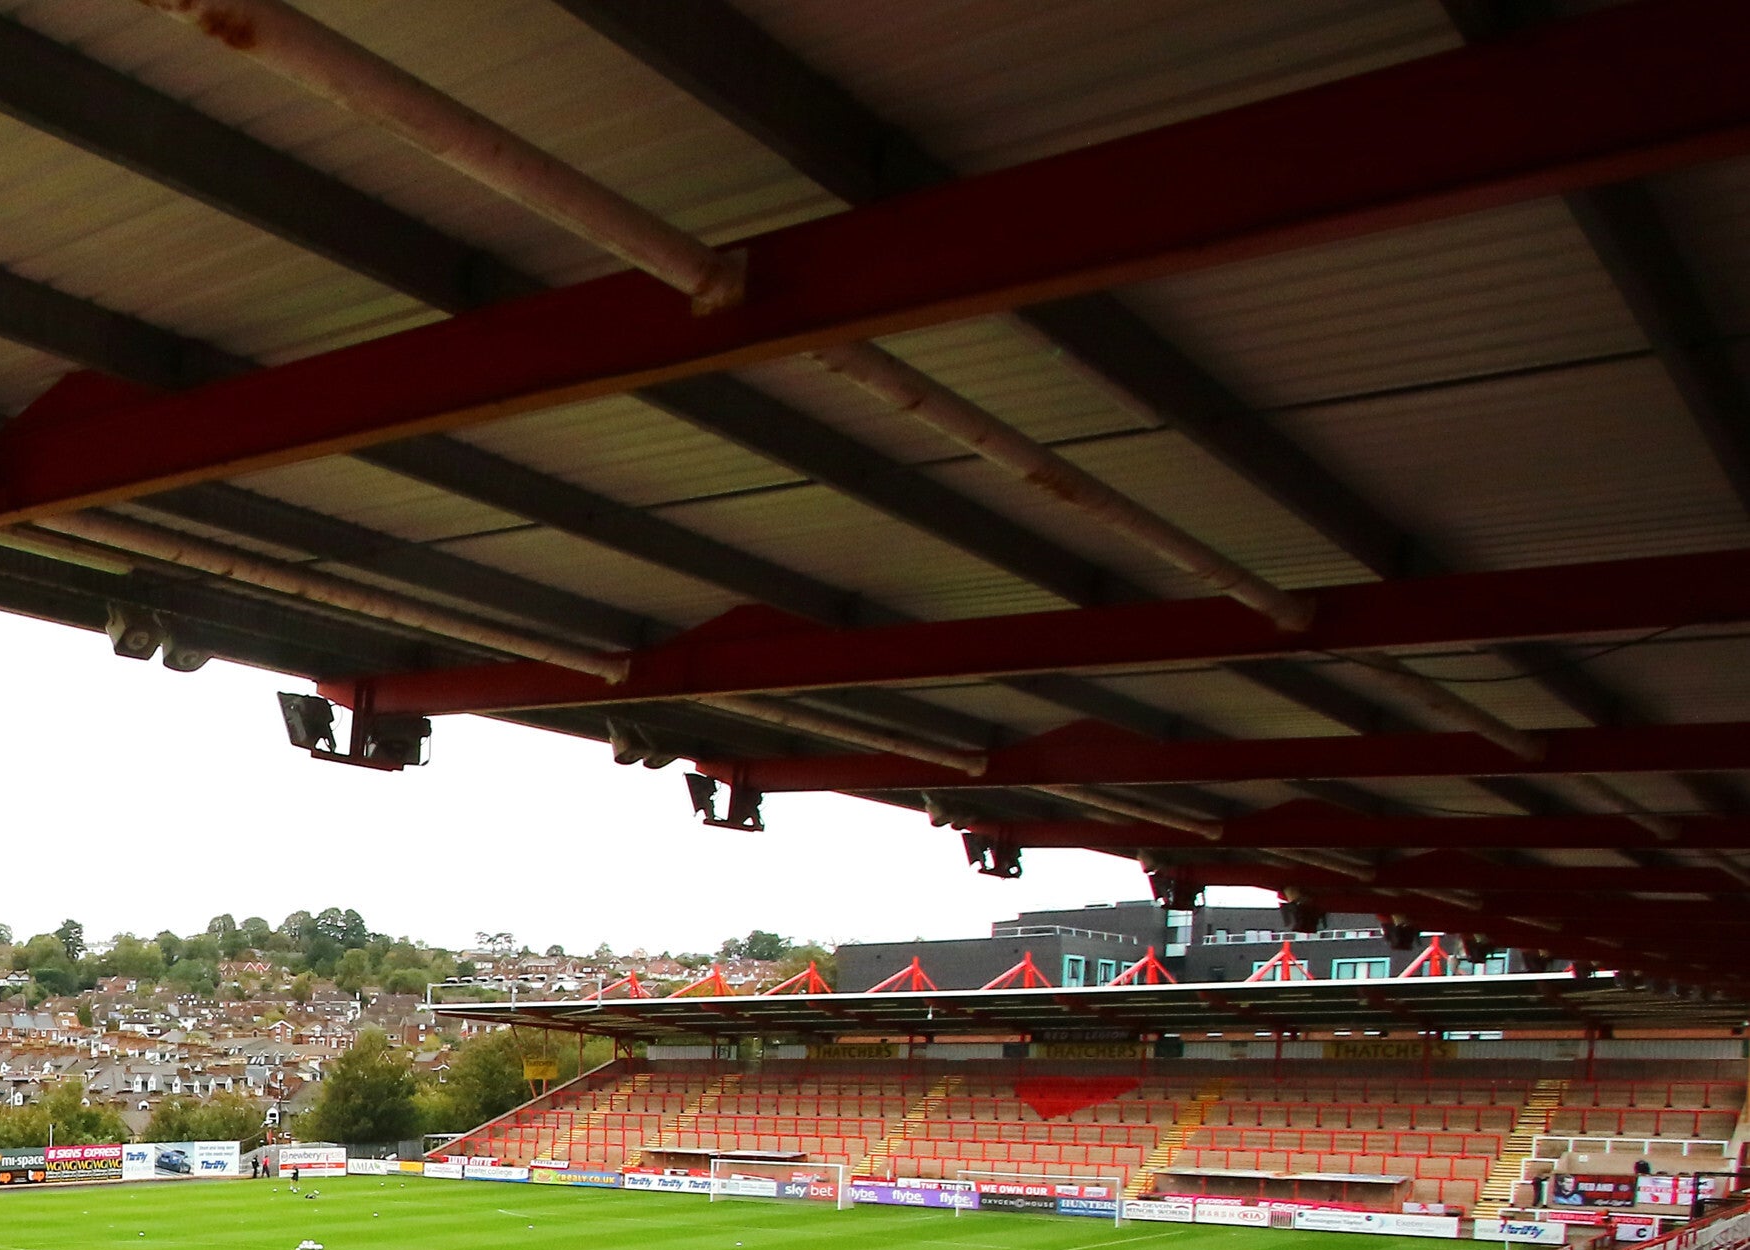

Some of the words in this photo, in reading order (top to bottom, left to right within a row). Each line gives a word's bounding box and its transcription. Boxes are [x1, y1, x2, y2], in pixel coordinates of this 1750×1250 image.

[1334, 1043, 1449, 1058] THATCHES
[55, 1149, 82, 1158] SIGNS
[83, 1147, 120, 1157] EXPRESS
[2, 1155, 45, 1168] mi-space
[201, 1161, 228, 1172] Thrifty
[627, 1176, 653, 1188] Thrifty
[657, 1178, 683, 1190] Thrifty
[785, 1183, 807, 1198] sky
[810, 1183, 834, 1197] bet
[980, 1184, 997, 1193] WE
[999, 1185, 1025, 1194] OWN
[1026, 1186, 1048, 1196] OUR
